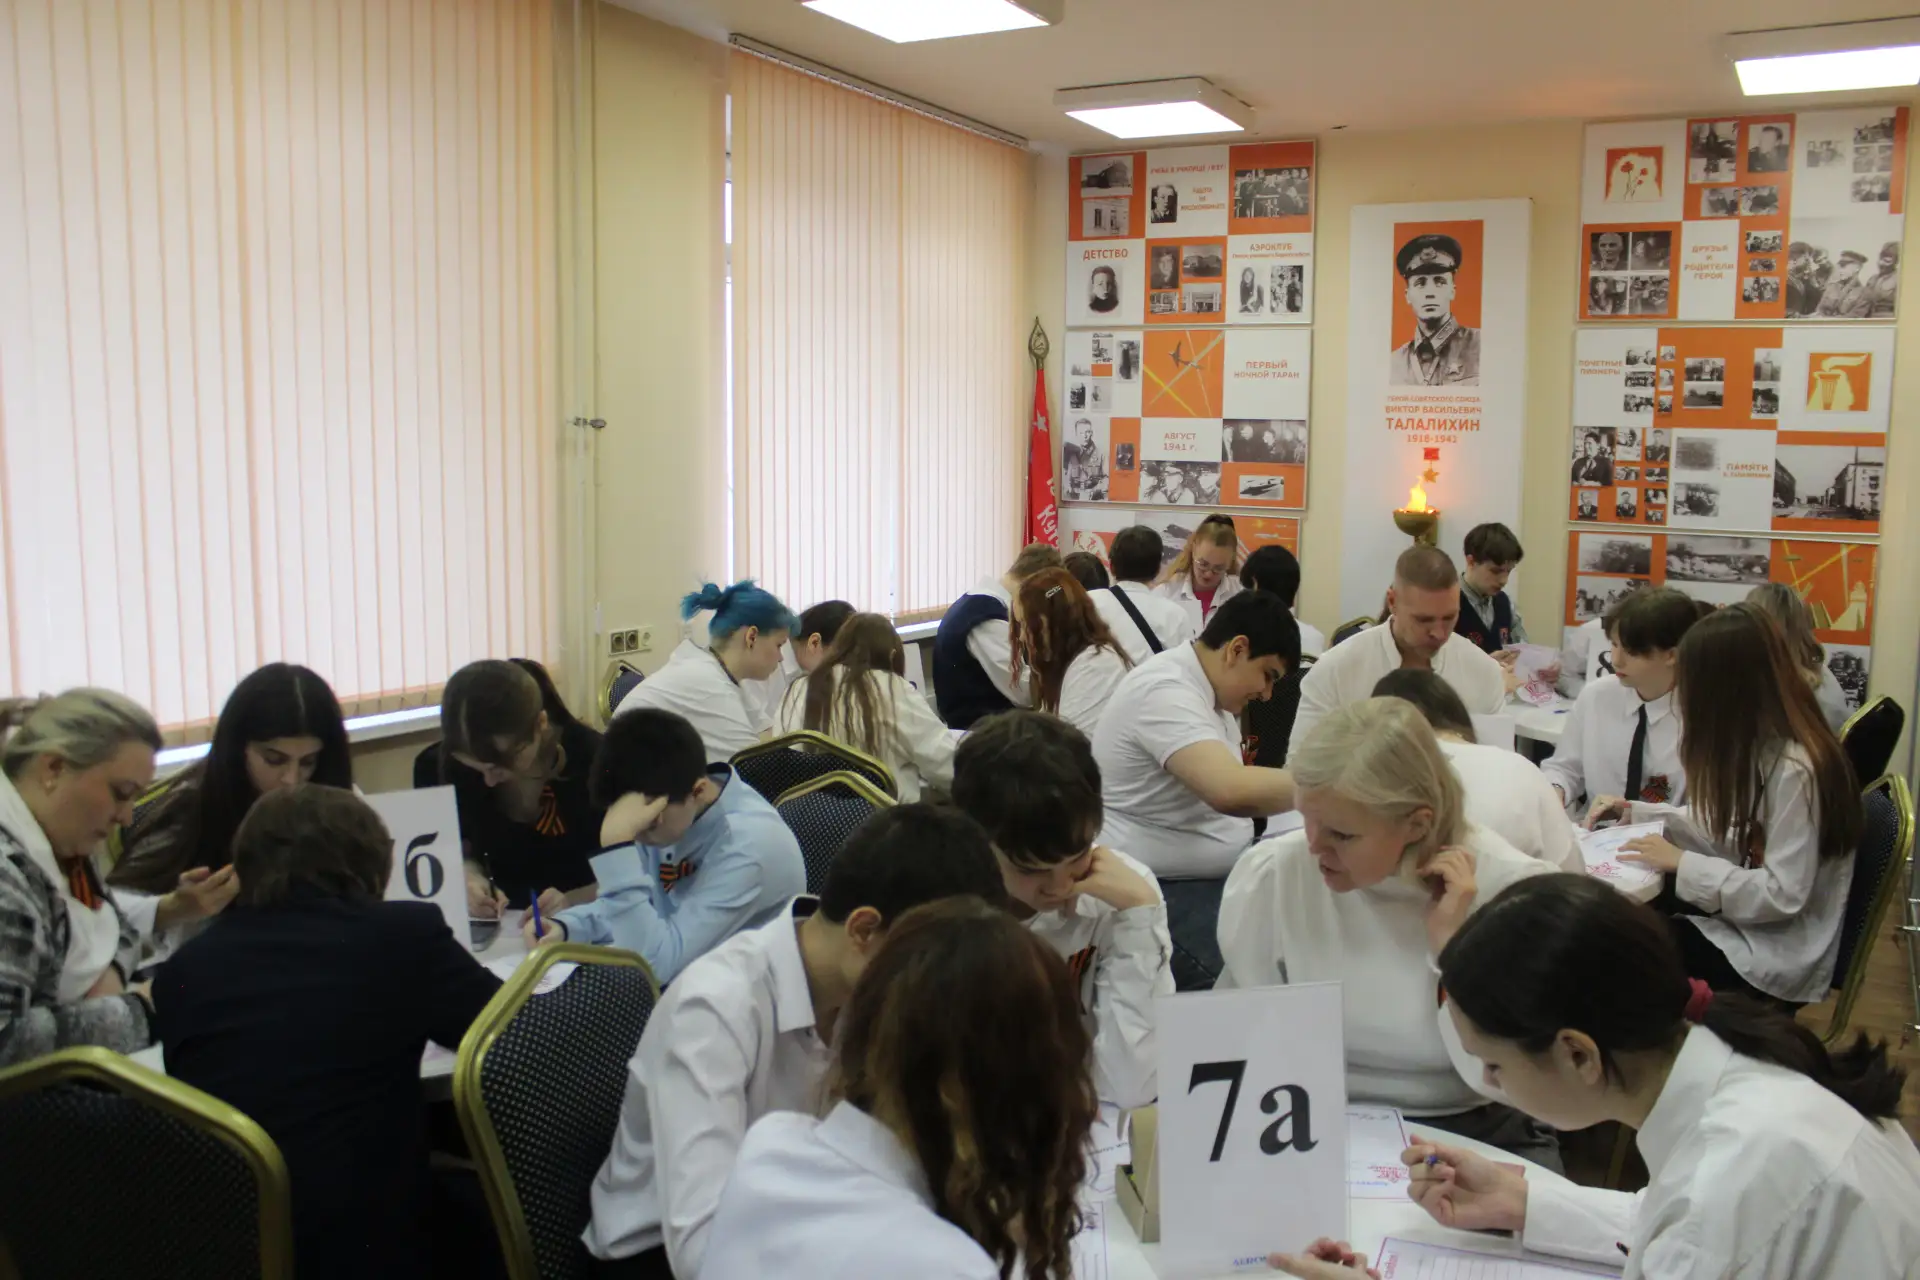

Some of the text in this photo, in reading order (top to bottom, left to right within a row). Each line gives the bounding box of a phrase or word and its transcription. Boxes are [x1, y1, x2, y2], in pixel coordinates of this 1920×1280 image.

[1250, 242, 1293, 251] АЭРОКЛУБ
[1692, 244, 1729, 253] ДРУЗЬЯ
[1083, 248, 1129, 261] ДЕТСТВО
[1684, 263, 1734, 271] РОДИТЕЛИ
[1245, 359, 1288, 369] ПЕРВЫЙ
[1234, 370, 1300, 379] НОЧНОЙ ТАРАН
[1422, 406, 1482, 414] ВАСИЛЬЕВИЧ
[1385, 417, 1481, 431] ТАЛАЛИХИН
[1164, 432, 1197, 440] АВГУСТ
[1407, 434, 1458, 443] 1918-1941
[1164, 443, 1187, 451] 1941
[1726, 462, 1769, 472] ПАМЯТИ
[1187, 1059, 1320, 1164] 7а
